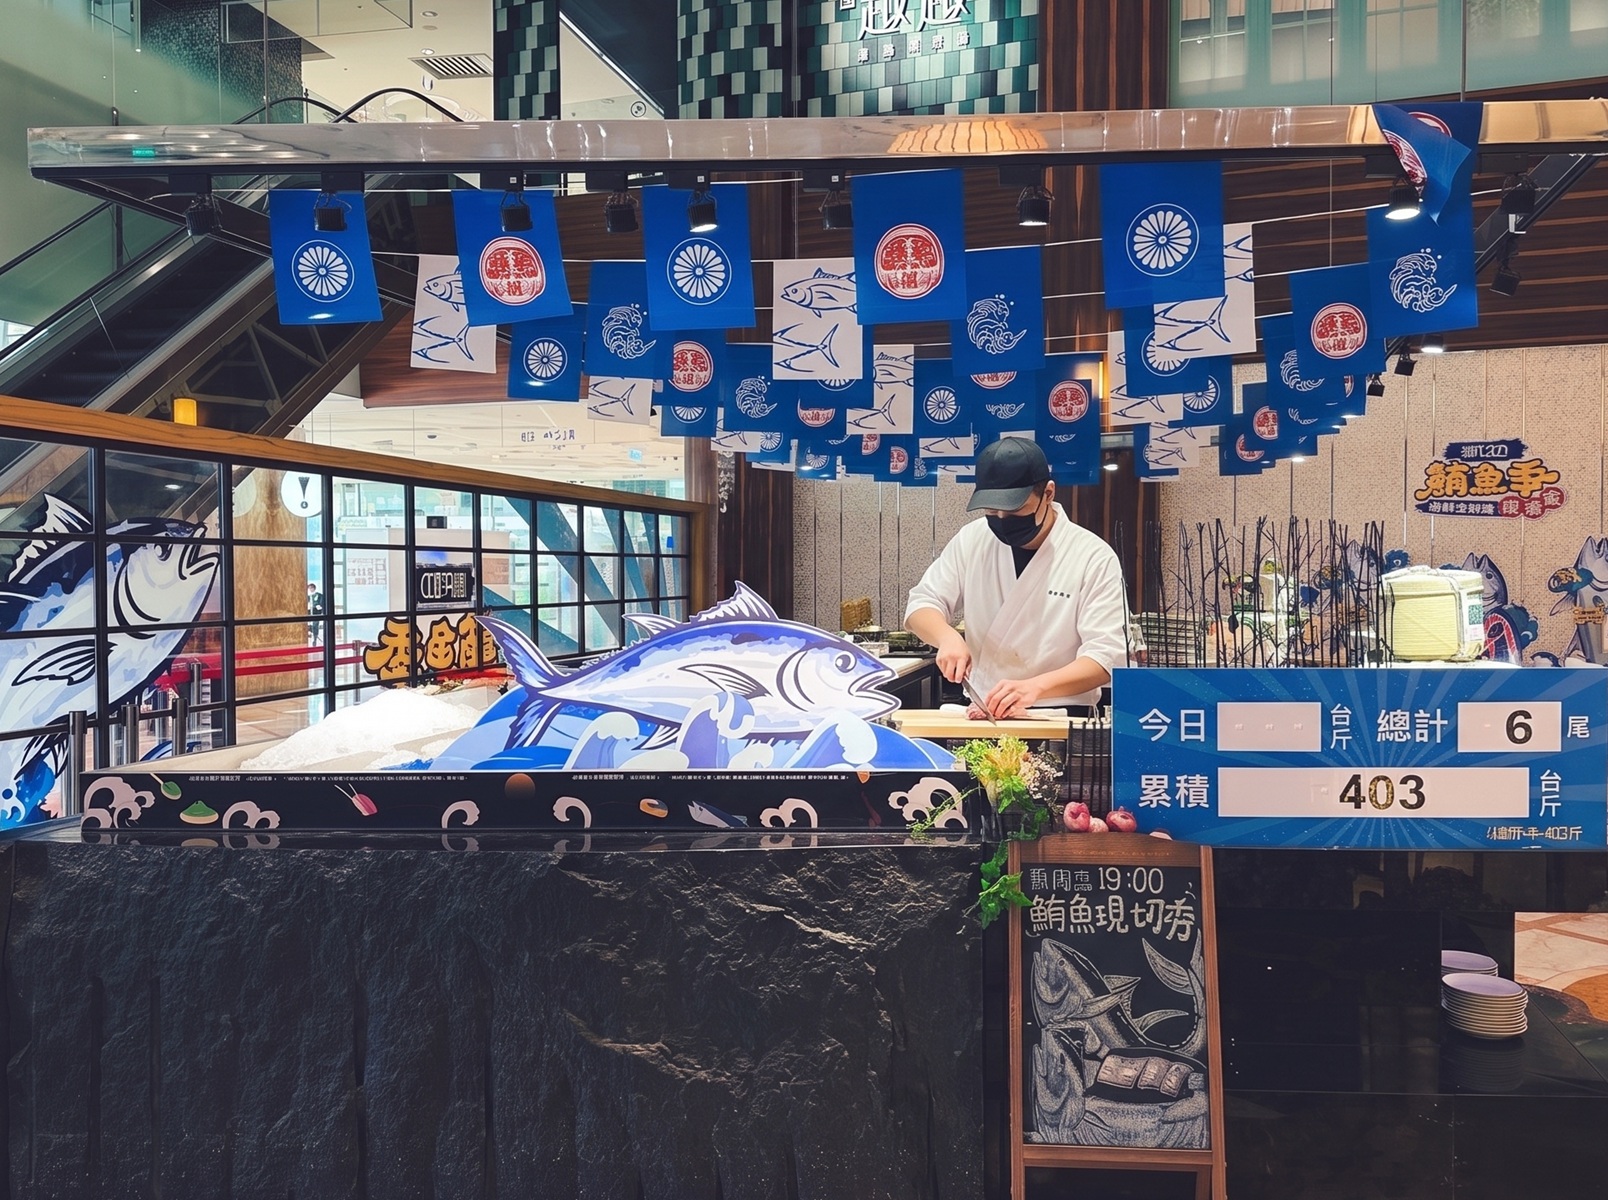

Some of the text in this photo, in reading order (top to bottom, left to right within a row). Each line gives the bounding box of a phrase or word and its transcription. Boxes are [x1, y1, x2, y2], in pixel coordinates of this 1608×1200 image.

[1138, 703, 1591, 750] 今日 台斤 總計 6 尾
[1138, 769, 1562, 818] 累積 403 台斤
[1098, 866, 1165, 895] 19:00
